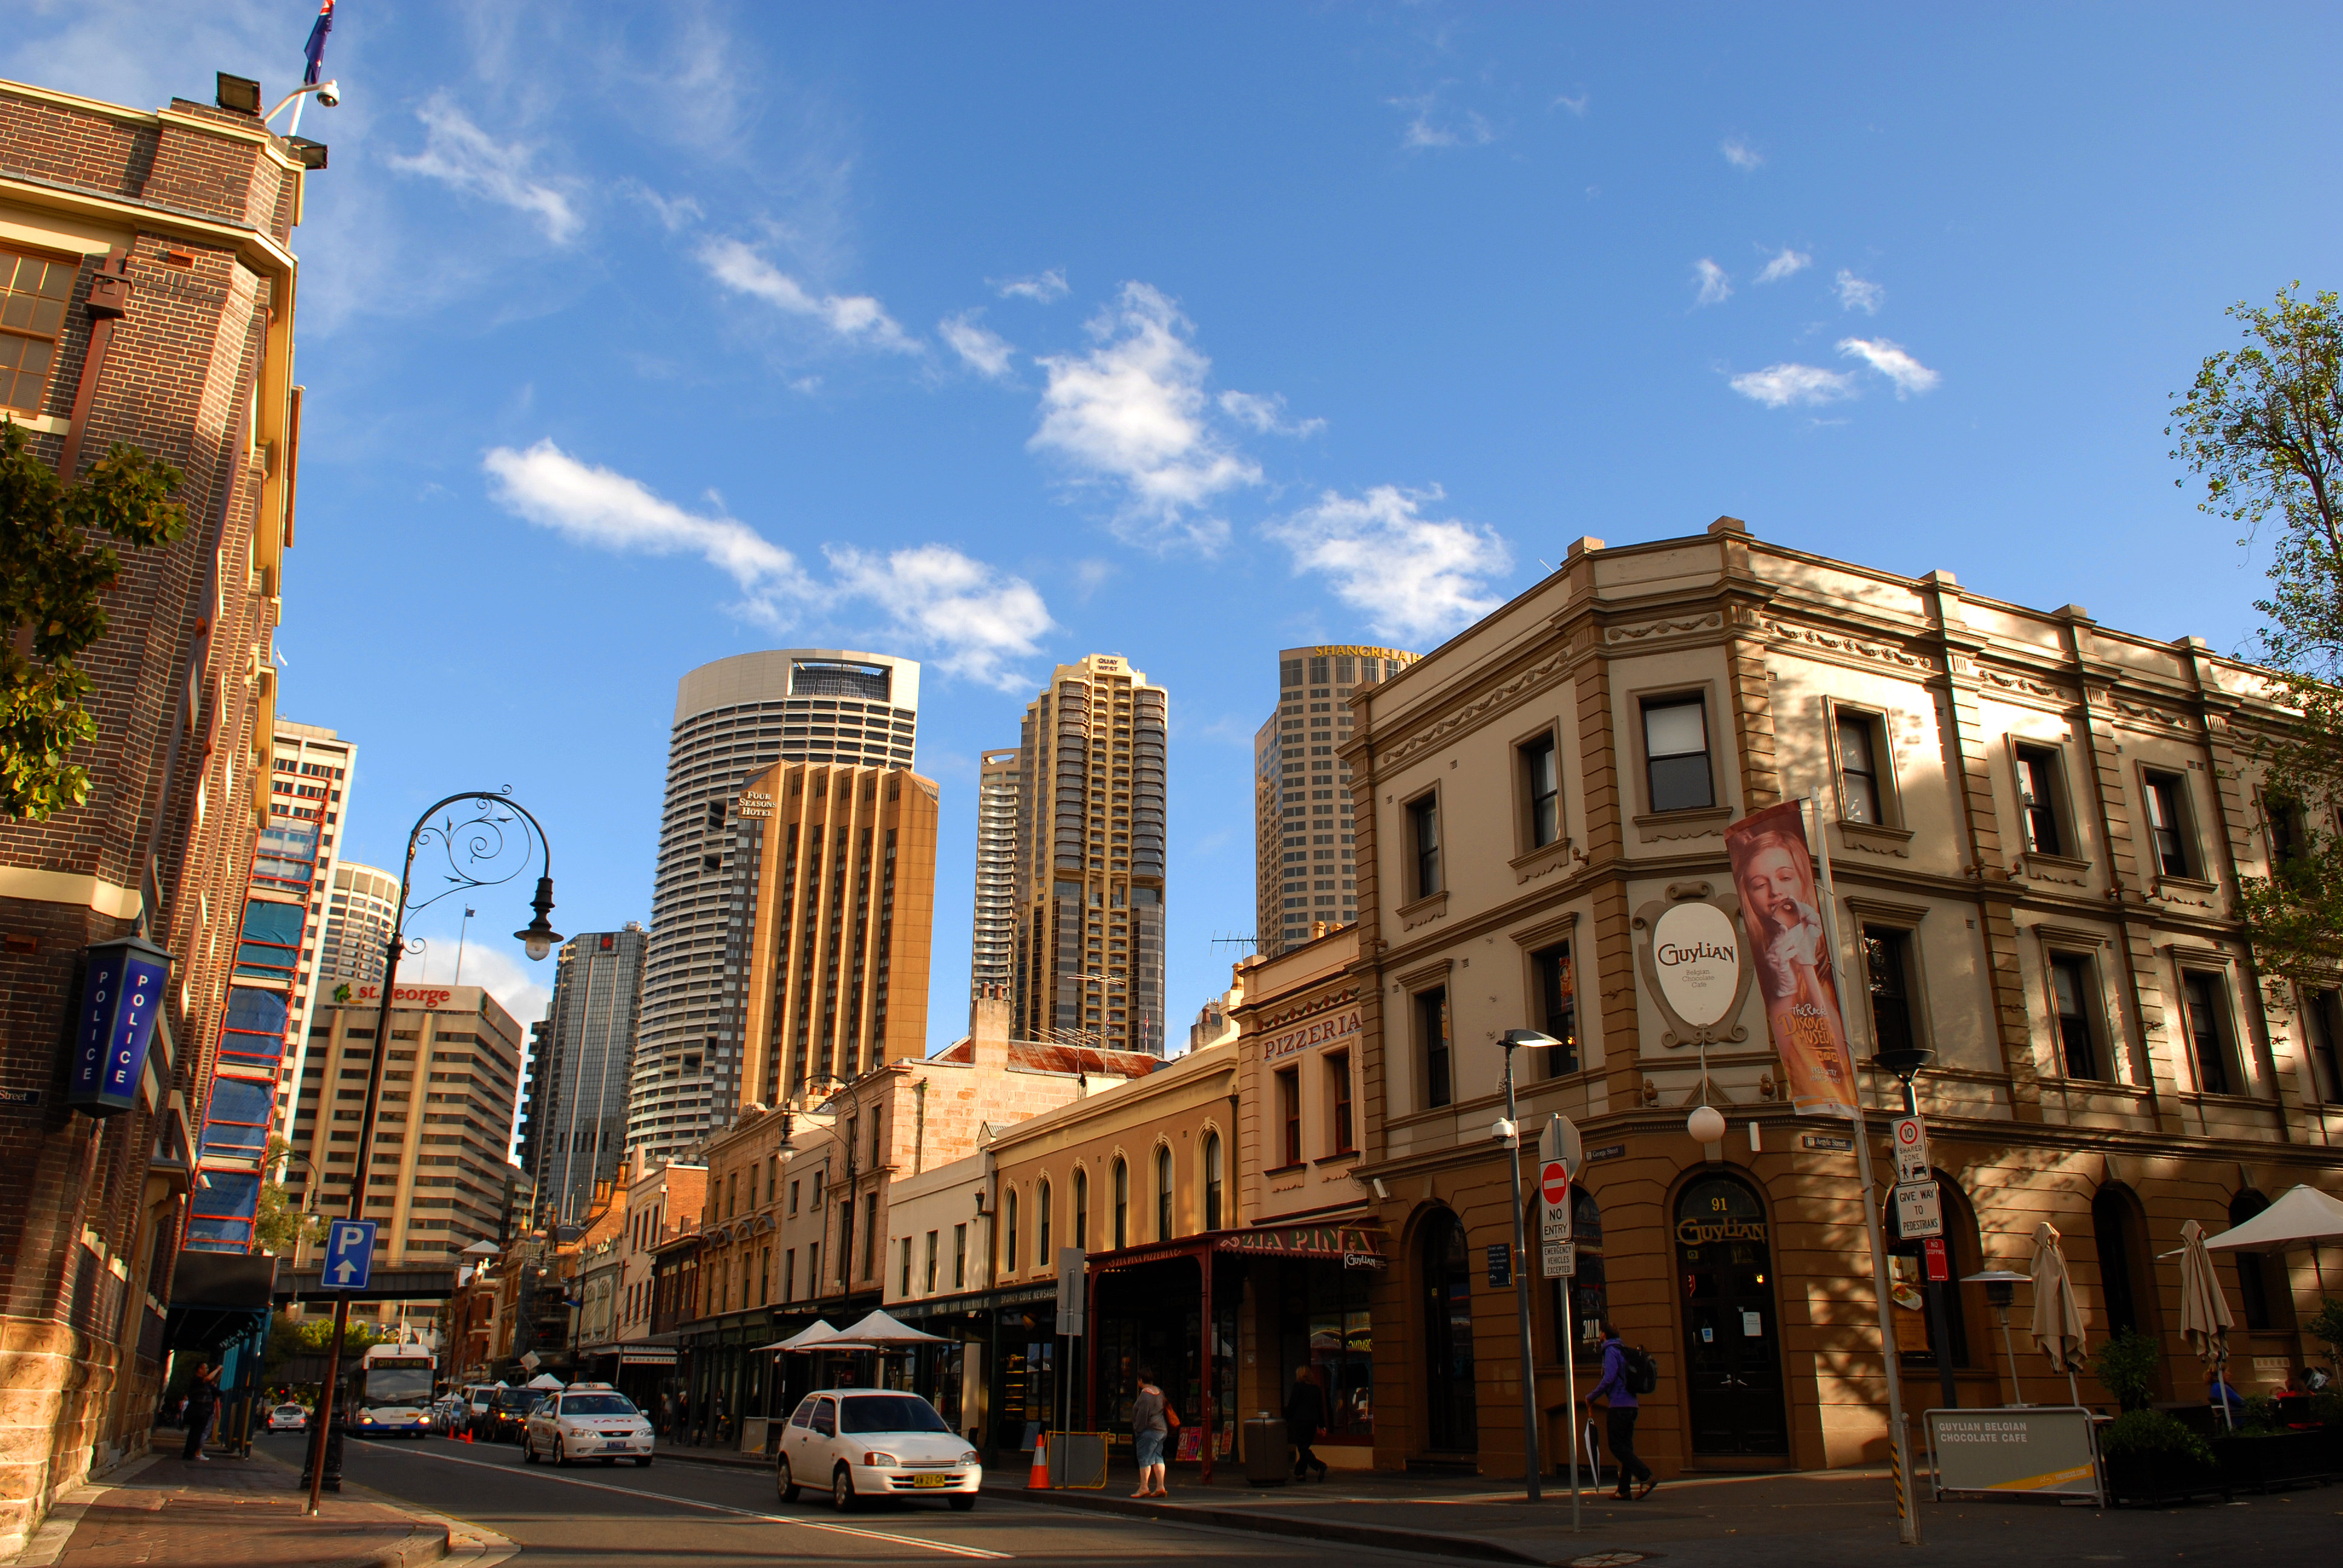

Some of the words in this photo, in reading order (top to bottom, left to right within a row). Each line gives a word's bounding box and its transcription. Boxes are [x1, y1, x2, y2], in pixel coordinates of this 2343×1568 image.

[1315, 645, 1407, 662] SHANGRI-LA
[747, 791, 771, 800] FOUR
[739, 798, 777, 808] SEASONS
[742, 807, 773, 816] HOTEL
[393, 987, 450, 1008] eorge
[1789, 1004, 1807, 1016] The
[83, 972, 108, 1080] POLICE
[116, 975, 148, 1083] POLICE
[1264, 1012, 1362, 1061] PIZZERIA
[0, 1089, 27, 1100] Street
[1904, 1128, 1913, 1138] 10
[1817, 1138, 1832, 1146] Argyle
[1899, 1145, 1922, 1154] SHARED
[1899, 1191, 1916, 1202] GIVE
[1920, 1189, 1935, 1199] WAY
[1711, 1197, 1728, 1211] 91
[1549, 1208, 1562, 1220] NO
[1914, 1206, 1924, 1215] TO
[1544, 1223, 1568, 1235] ENTRY
[1903, 1218, 1938, 1231] PEDESTRIANS
[338, 1227, 364, 1255] P
[1242, 1233, 1283, 1250] ZIA
[1290, 1229, 1374, 1253] PINA
[1128, 1255, 1142, 1264] PINA
[1144, 1250, 1173, 1262] PIZZERIA
[1544, 1247, 1571, 1255] EMERGENCY
[1547, 1266, 1570, 1274] EXCEPTED
[1001, 1293, 1017, 1304] SYDNEY
[1019, 1292, 1031, 1301] COVE
[1939, 1422, 1981, 1431] GUYLIAN
[1985, 1422, 2027, 1431] BELGIAN
[1941, 1434, 1997, 1442] CHOCOLATE
[2002, 1434, 2027, 1442] CAFE
